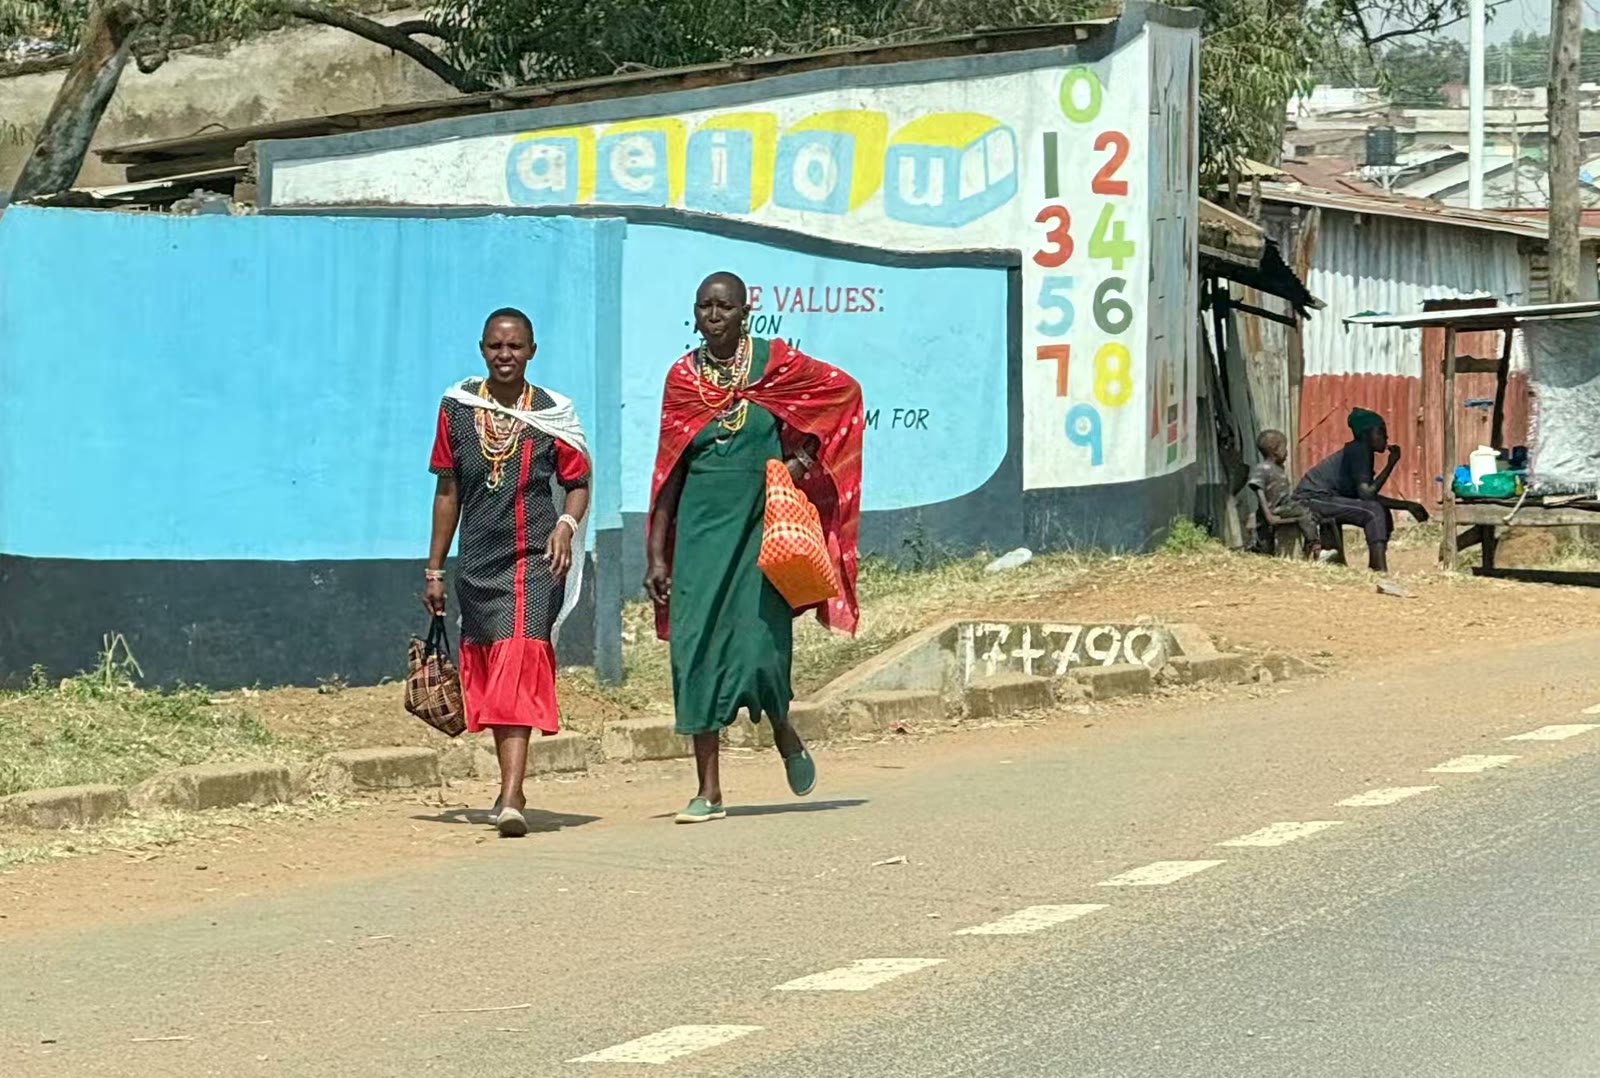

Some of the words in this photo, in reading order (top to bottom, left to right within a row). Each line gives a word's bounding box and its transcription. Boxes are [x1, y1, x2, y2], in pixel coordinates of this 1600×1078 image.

[1059, 68, 1102, 124] 0
[609, 135, 657, 192] e
[711, 132, 727, 189] i
[900, 157, 944, 206] u
[1091, 131, 1130, 196] 2
[1032, 205, 1075, 268] 3
[1088, 202, 1135, 270] 4
[773, 286, 885, 313] VALUES:
[1036, 275, 1075, 337] 5
[1092, 277, 1133, 335] 6
[1036, 344, 1071, 397] 7
[1092, 342, 1133, 407] 8
[891, 408, 930, 430] FOR
[1064, 403, 1104, 466] 9
